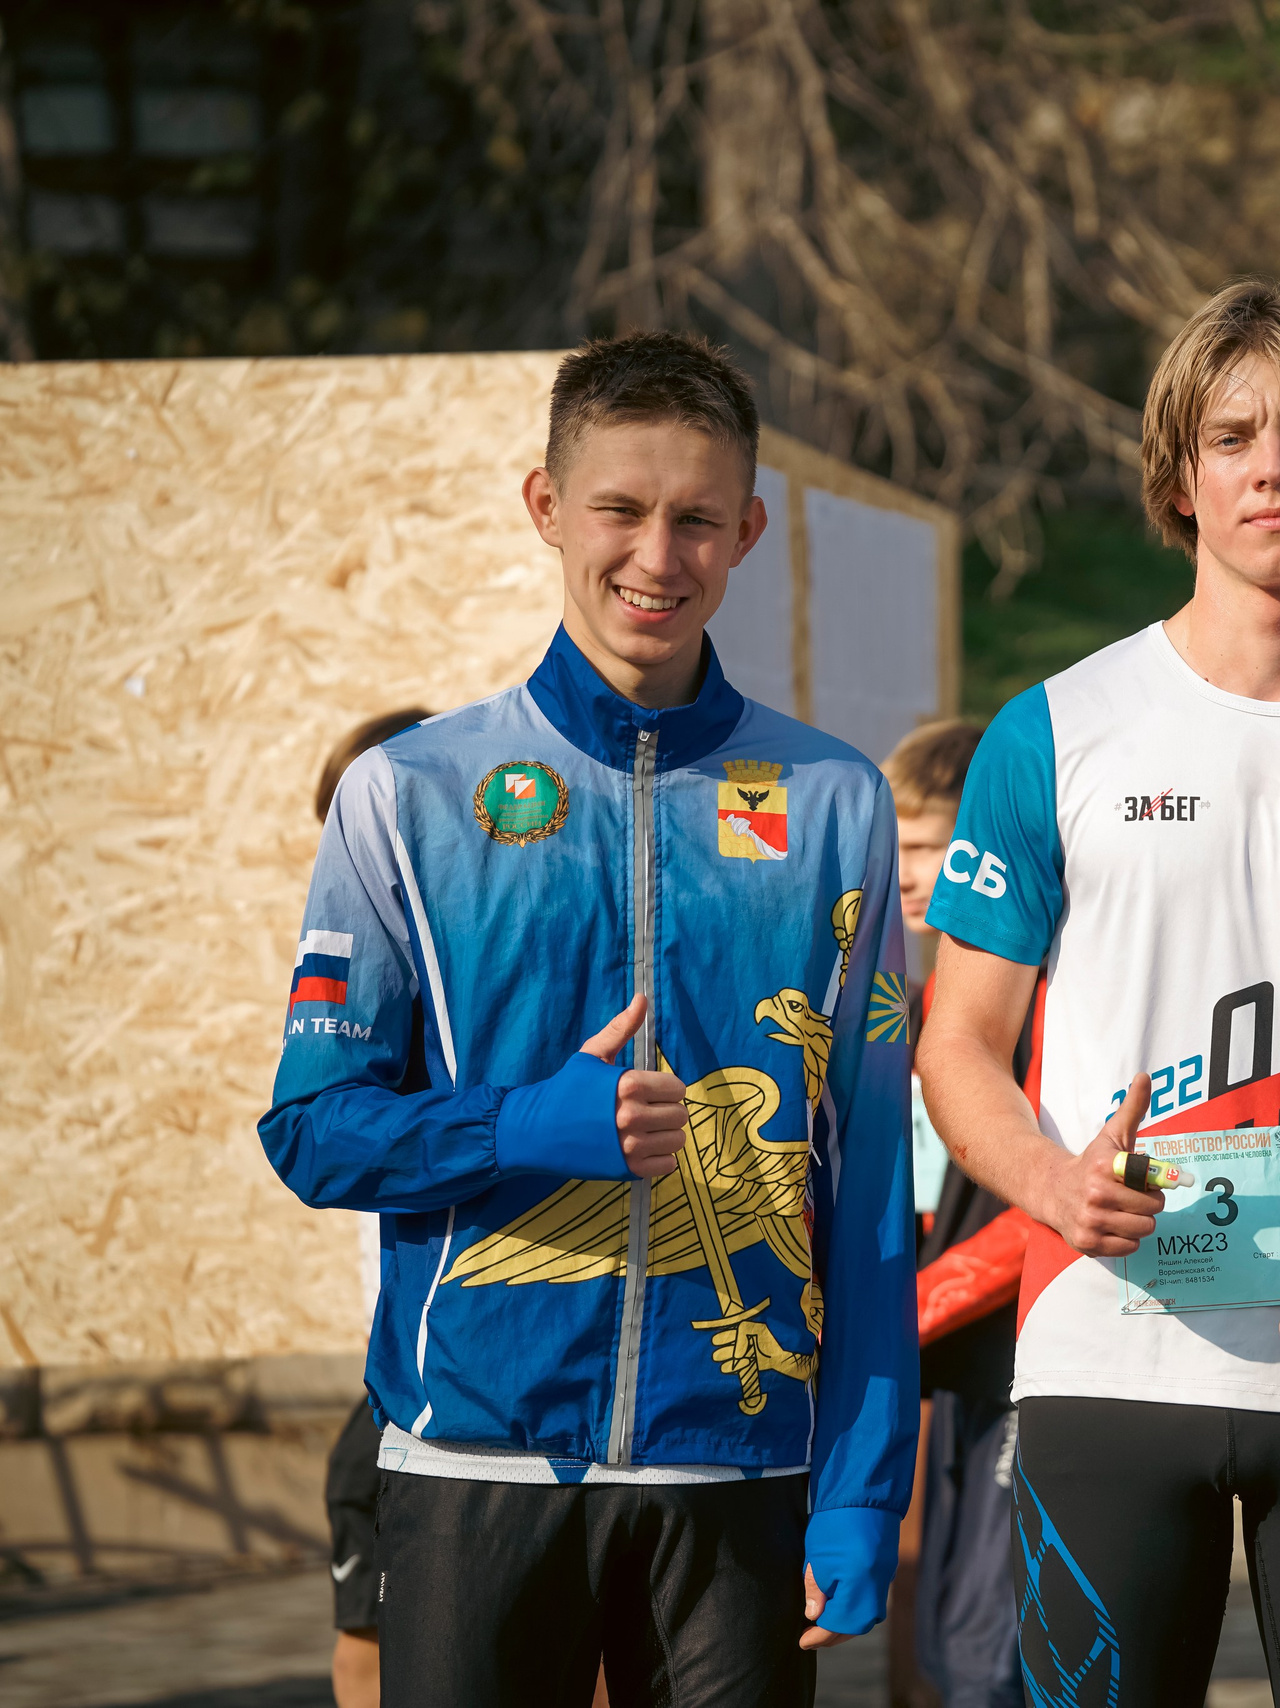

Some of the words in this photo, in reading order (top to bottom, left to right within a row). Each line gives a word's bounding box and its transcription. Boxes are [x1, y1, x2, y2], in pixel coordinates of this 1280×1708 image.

[943, 839, 1007, 899] СБ
[311, 1017, 372, 1041] TEAM
[1153, 1136, 1223, 1156] ПЕРВЕНСТВО
[1225, 1132, 1271, 1149] РОССИИ
[1176, 1156, 1188, 1165] 2025
[1245, 1149, 1273, 1159] ЧЕЛОВЕКА
[1205, 1177, 1239, 1226] 3
[1157, 1232, 1228, 1256] МЖ23
[1184, 1256, 1213, 1264] Алексей
[1253, 1251, 1275, 1260] Старт
[1158, 1267, 1206, 1277] Воронежская
[1207, 1265, 1222, 1273] обл.
[1185, 1275, 1215, 1284] 8481534
